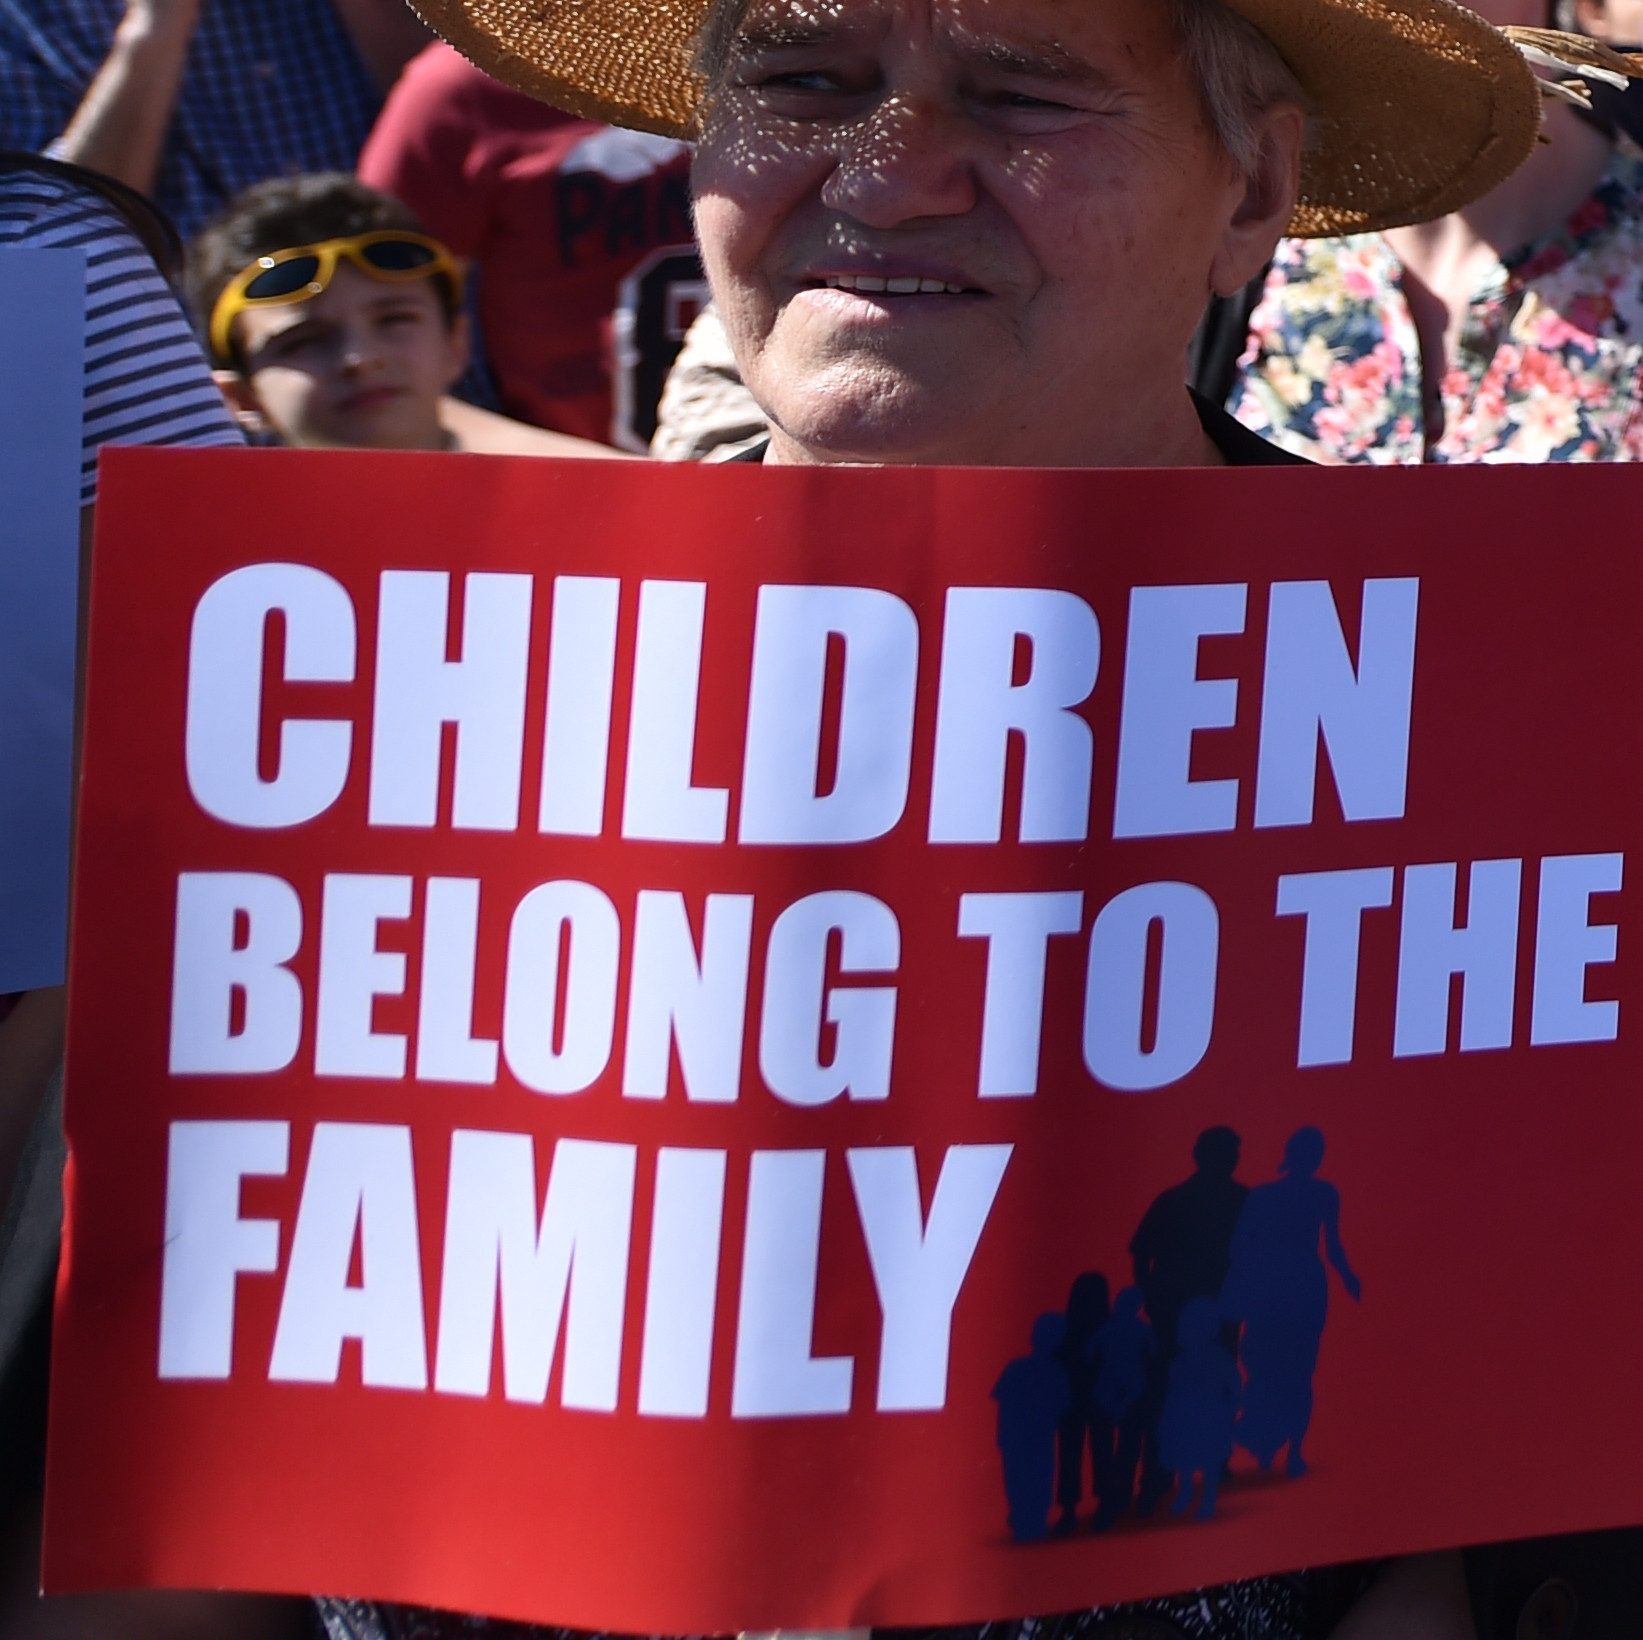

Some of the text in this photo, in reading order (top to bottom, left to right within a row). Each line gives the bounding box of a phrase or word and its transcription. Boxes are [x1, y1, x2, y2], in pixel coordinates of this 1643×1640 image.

[184, 561, 1421, 846] CHILDREN
[168, 852, 1625, 1107] BELONG TO THE
[158, 1118, 1015, 1421] FAMILY
